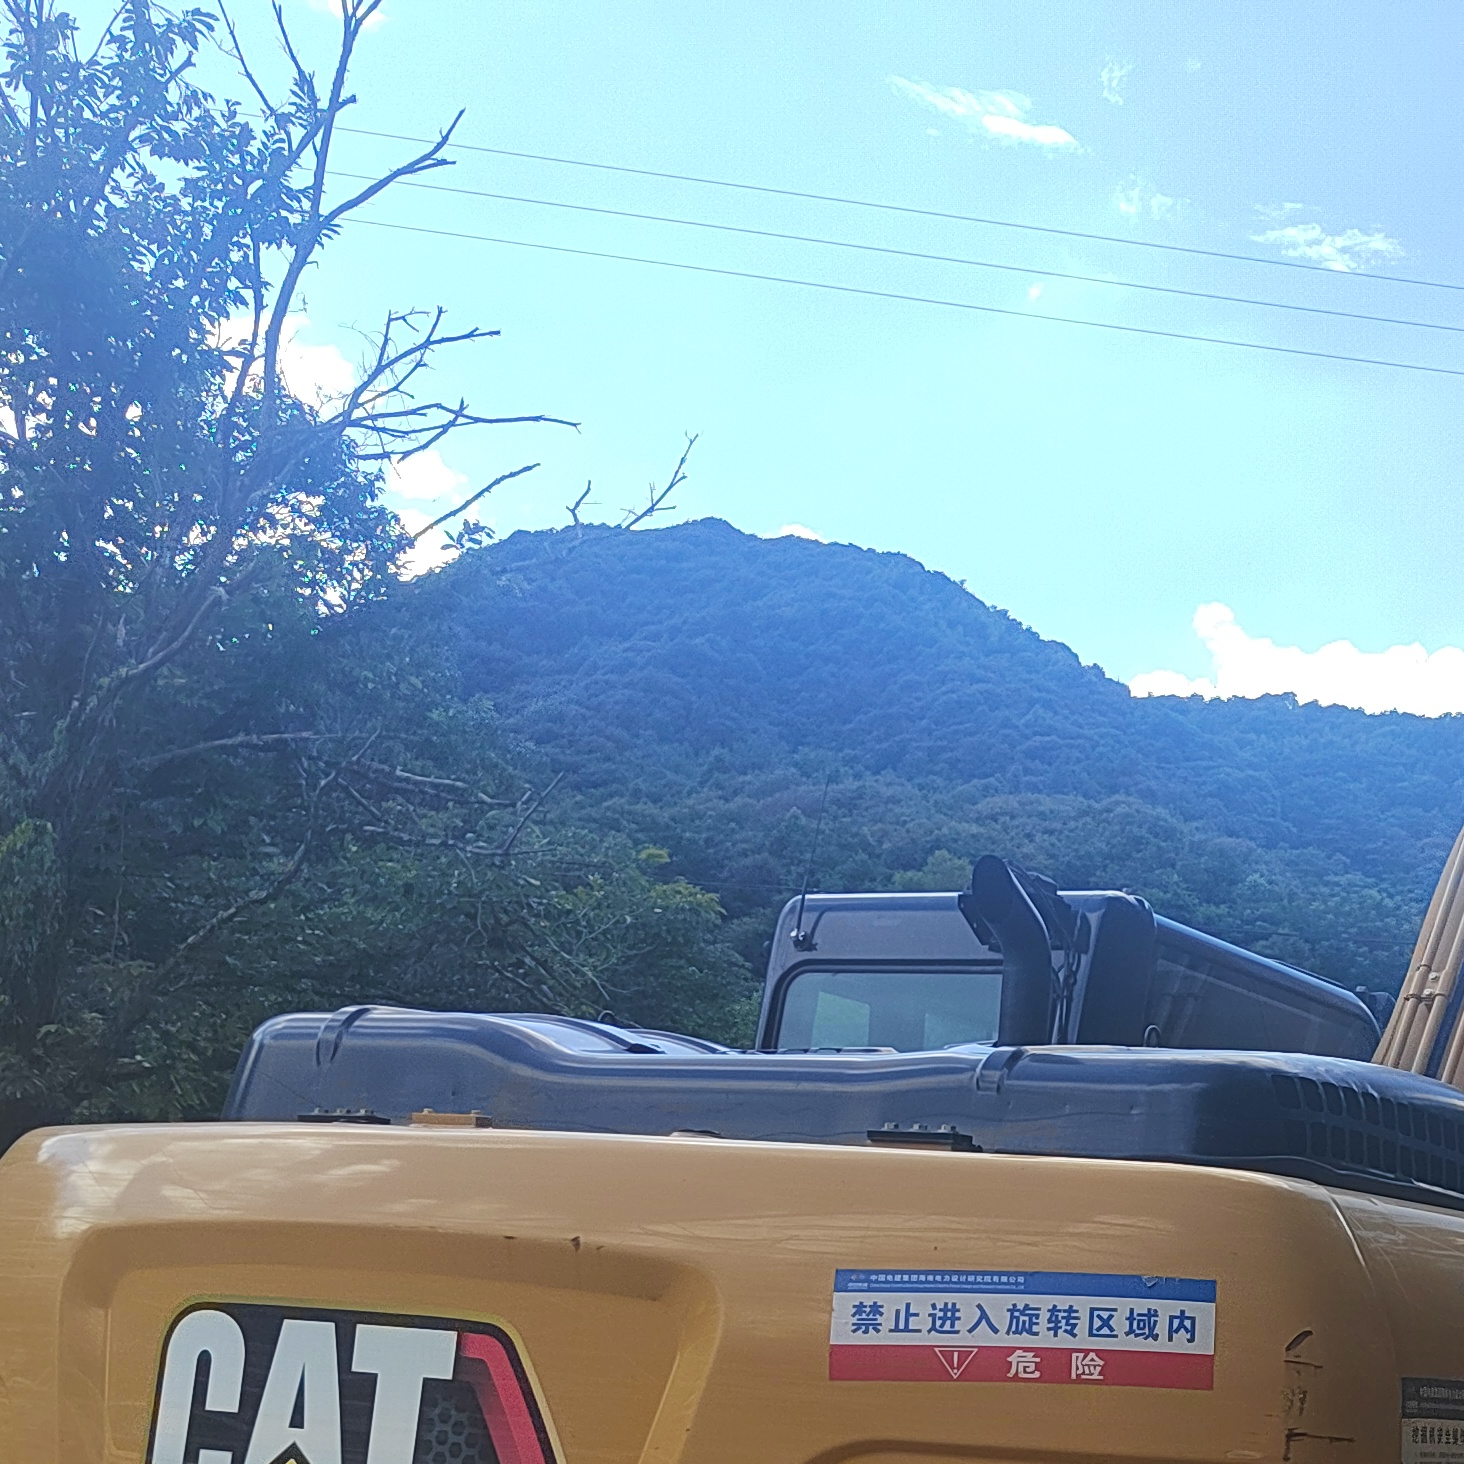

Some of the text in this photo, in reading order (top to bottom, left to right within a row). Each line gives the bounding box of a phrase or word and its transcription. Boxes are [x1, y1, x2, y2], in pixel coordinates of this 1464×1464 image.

[850, 1301, 1197, 1343] 禁止进入旋转区域内
[1006, 1349, 1104, 1380] 危险
